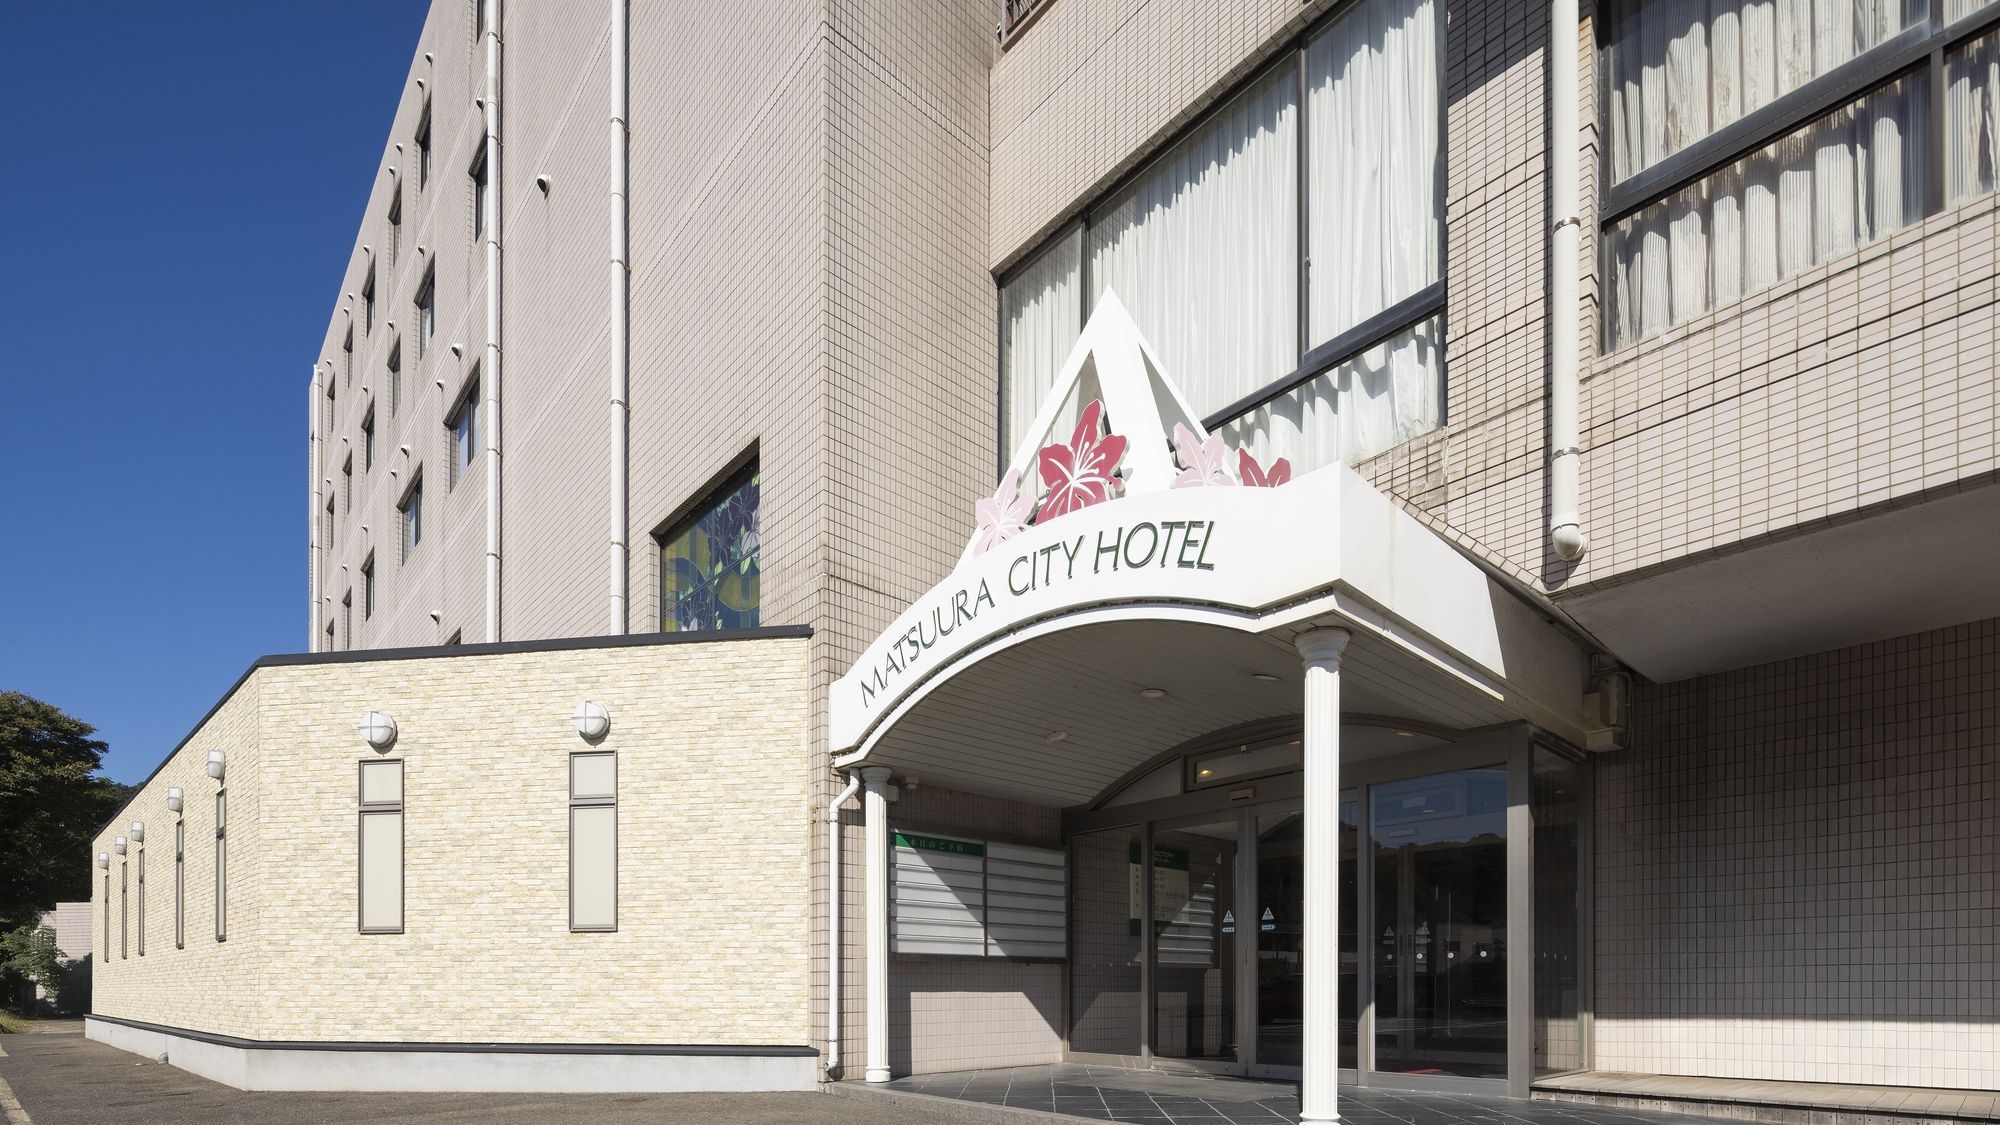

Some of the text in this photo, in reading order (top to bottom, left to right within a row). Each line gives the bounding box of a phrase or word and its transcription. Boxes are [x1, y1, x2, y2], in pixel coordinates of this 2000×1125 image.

[860, 520, 1215, 708] MATSUURA CITY HOTEL
